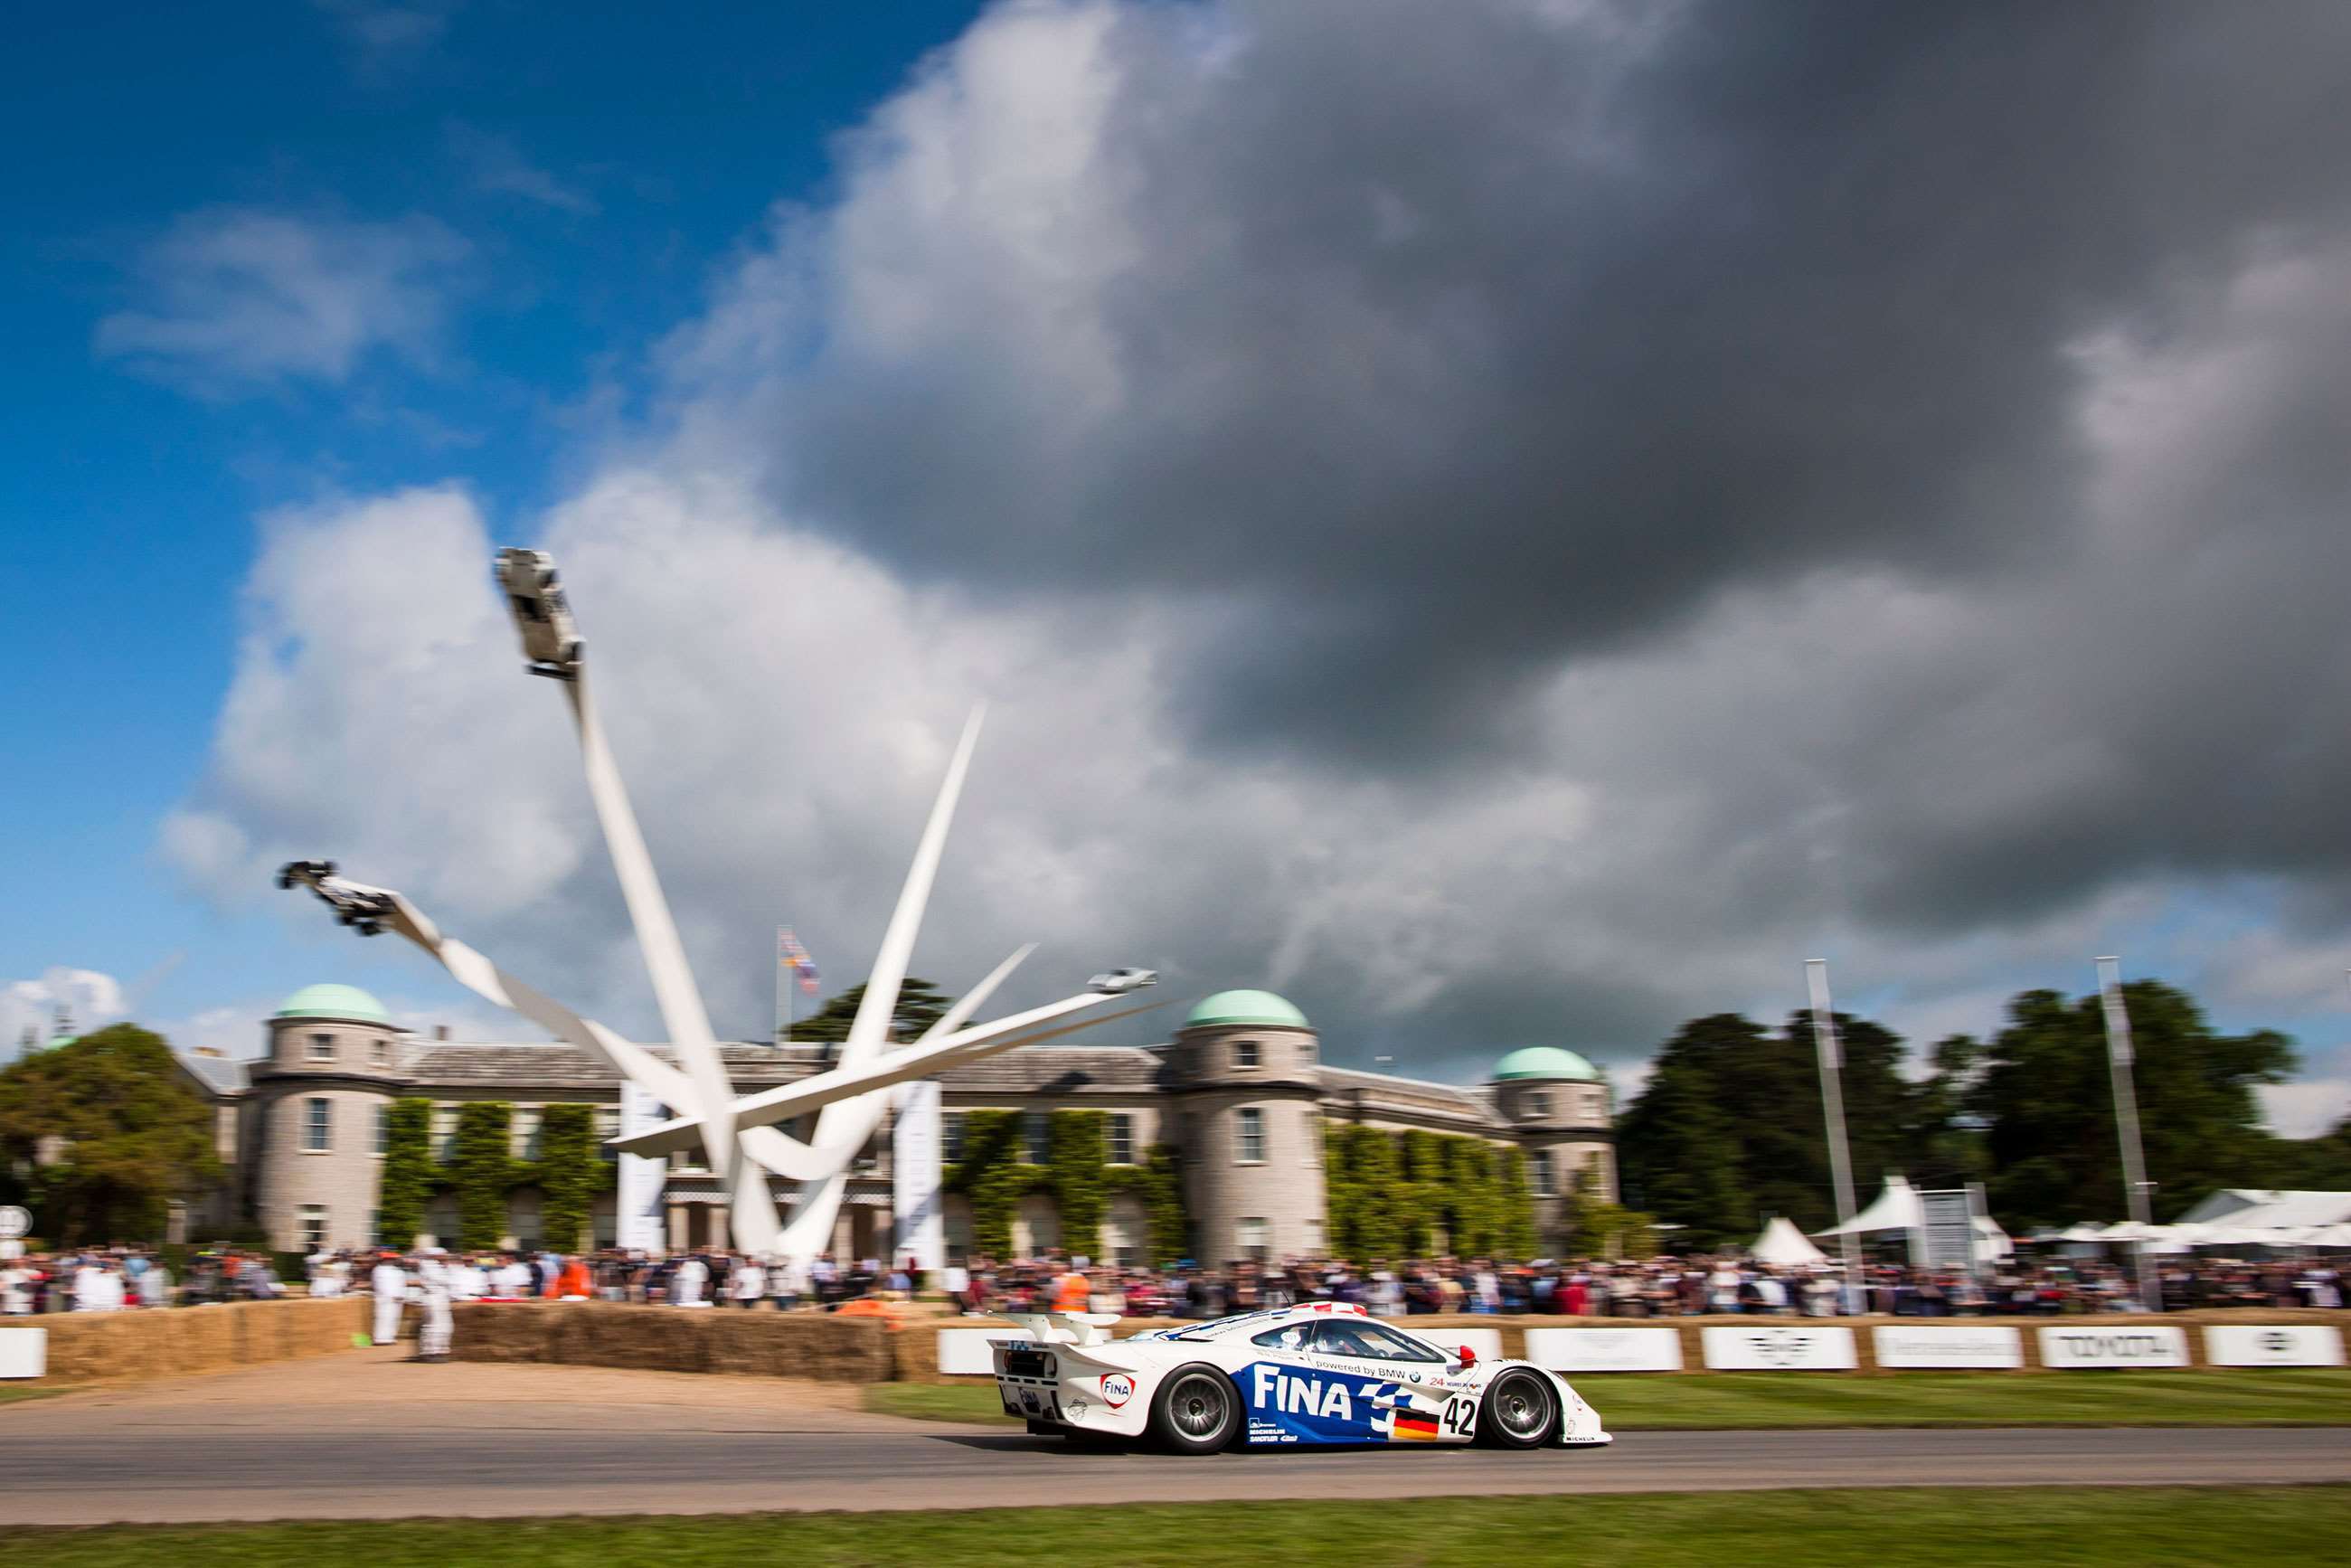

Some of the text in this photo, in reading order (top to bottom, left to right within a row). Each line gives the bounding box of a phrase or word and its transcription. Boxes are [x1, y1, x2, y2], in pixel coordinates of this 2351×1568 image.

[1316, 1360, 1406, 1379] powered by BMW
[1104, 1381, 1129, 1396] FINA
[1429, 1377, 1445, 1386] 24
[1254, 1364, 1352, 1421] FINA
[1443, 1397, 1476, 1437] 42
